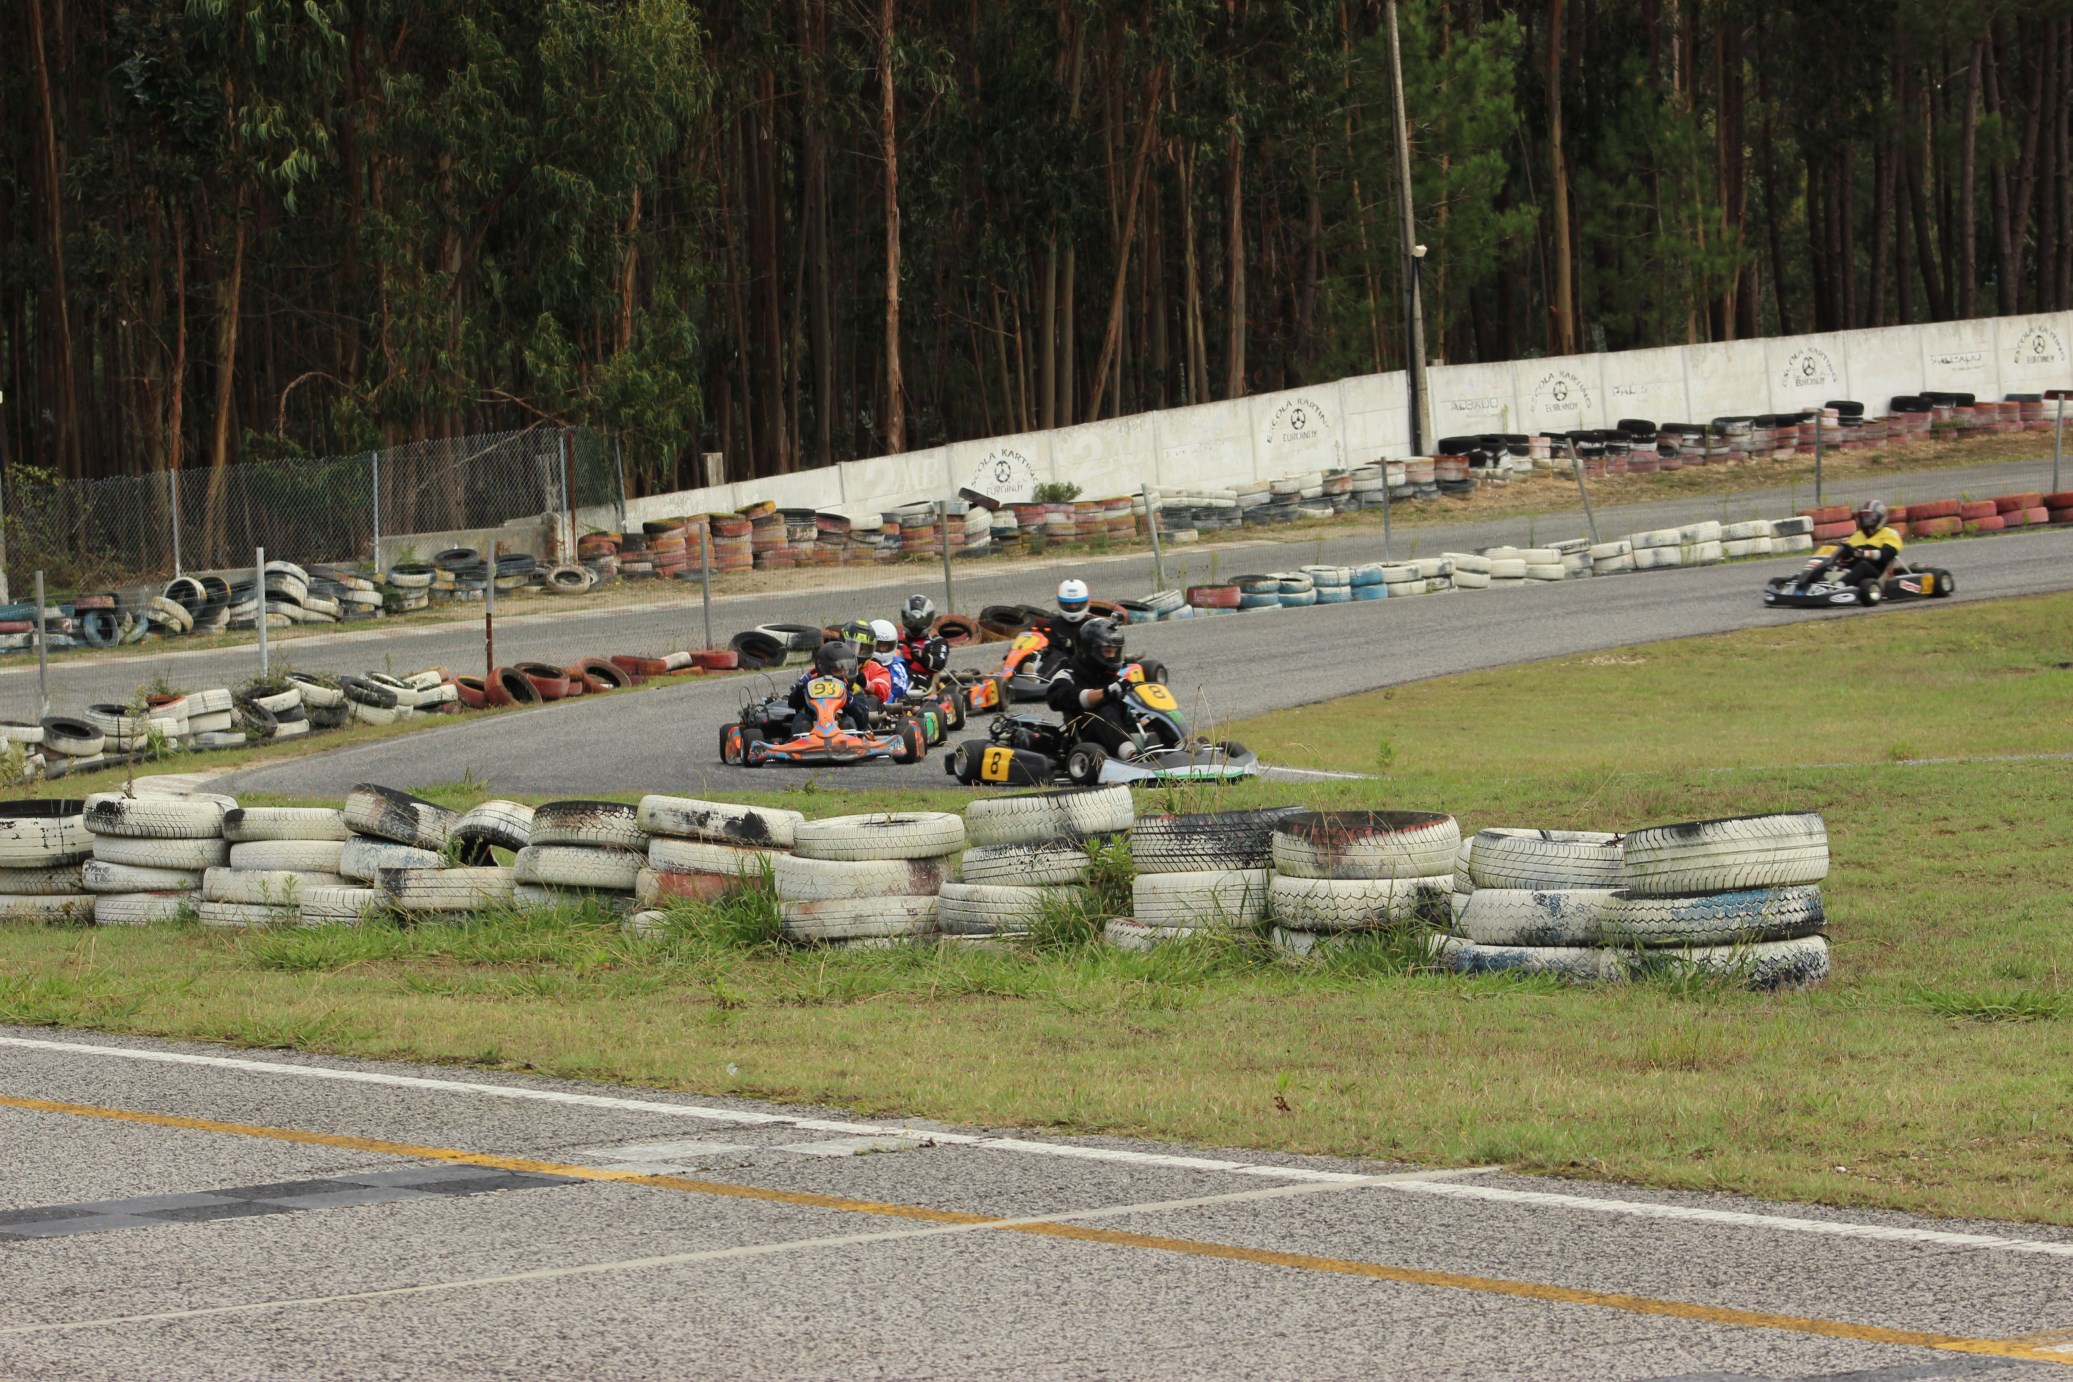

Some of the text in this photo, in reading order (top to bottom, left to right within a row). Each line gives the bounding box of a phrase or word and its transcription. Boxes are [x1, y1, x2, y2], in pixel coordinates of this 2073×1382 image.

[813, 682, 836, 696] 93
[1148, 685, 1167, 699] 8
[991, 751, 1002, 775] 8
